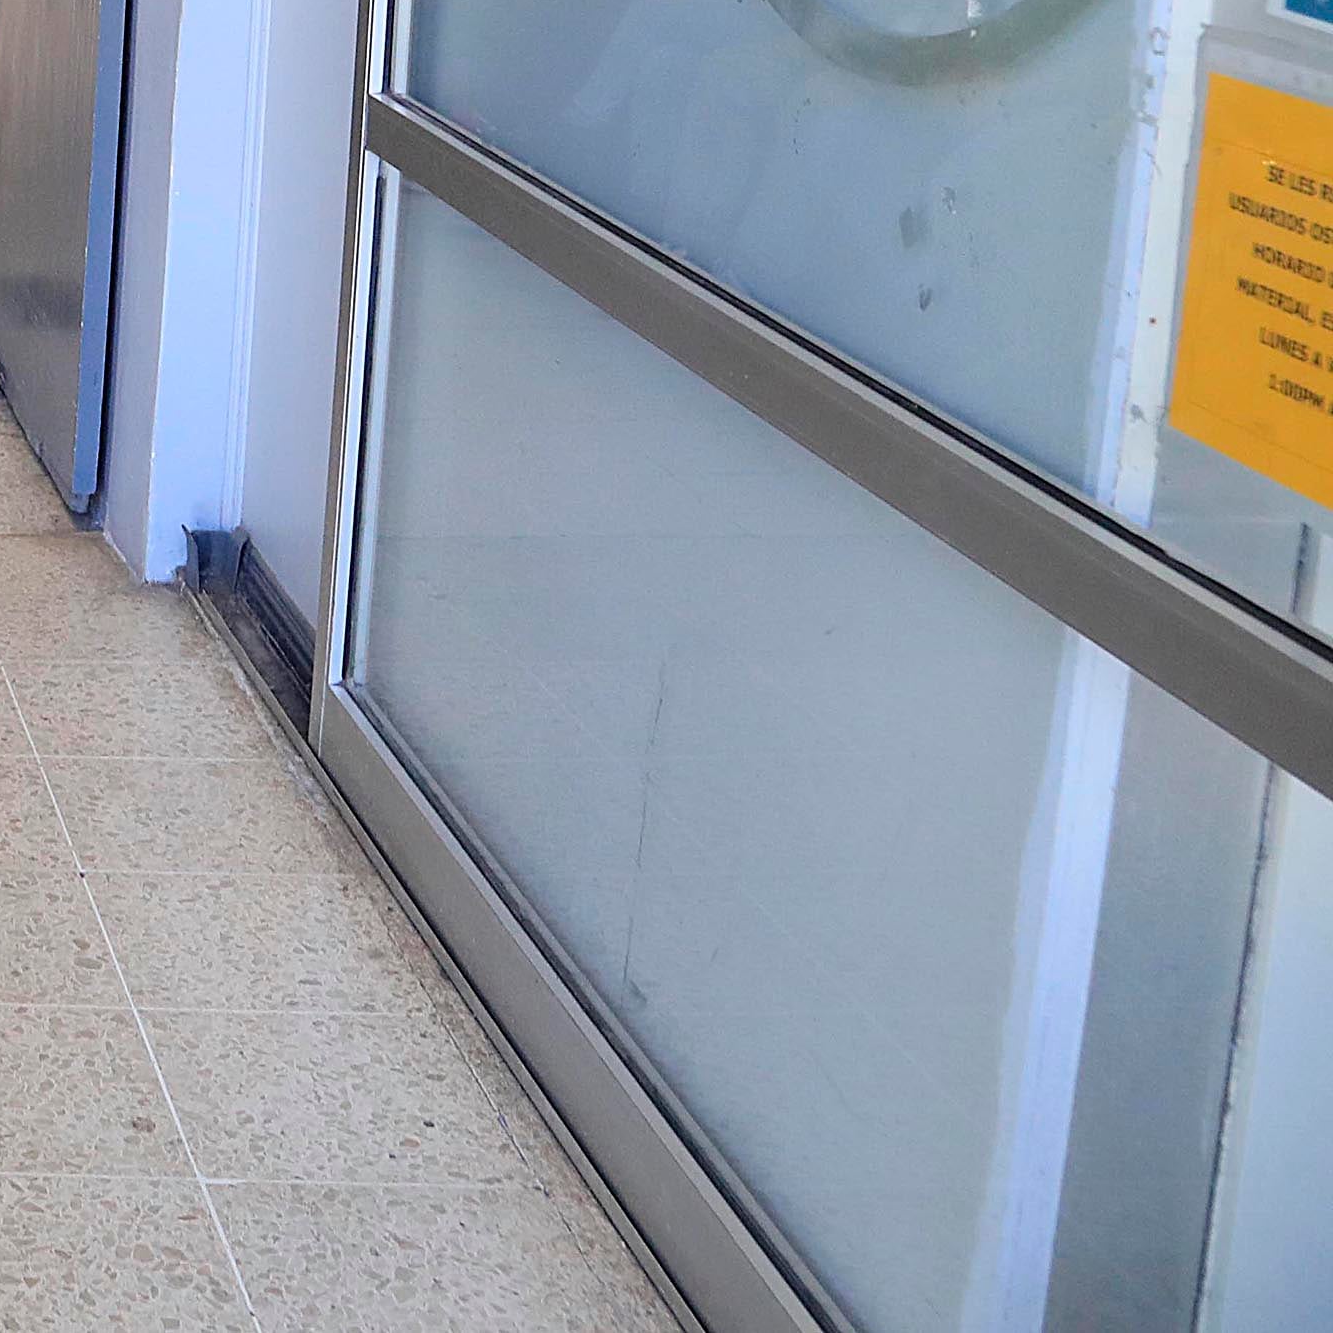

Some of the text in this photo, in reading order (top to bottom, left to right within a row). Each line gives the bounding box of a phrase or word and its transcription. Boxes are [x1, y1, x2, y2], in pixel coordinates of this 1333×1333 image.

[1289, 174, 1317, 197] LES
[1229, 191, 1307, 235] USUARIOS
[1253, 243, 1325, 283] HORARIO
[1259, 326, 1309, 362] LUNES
